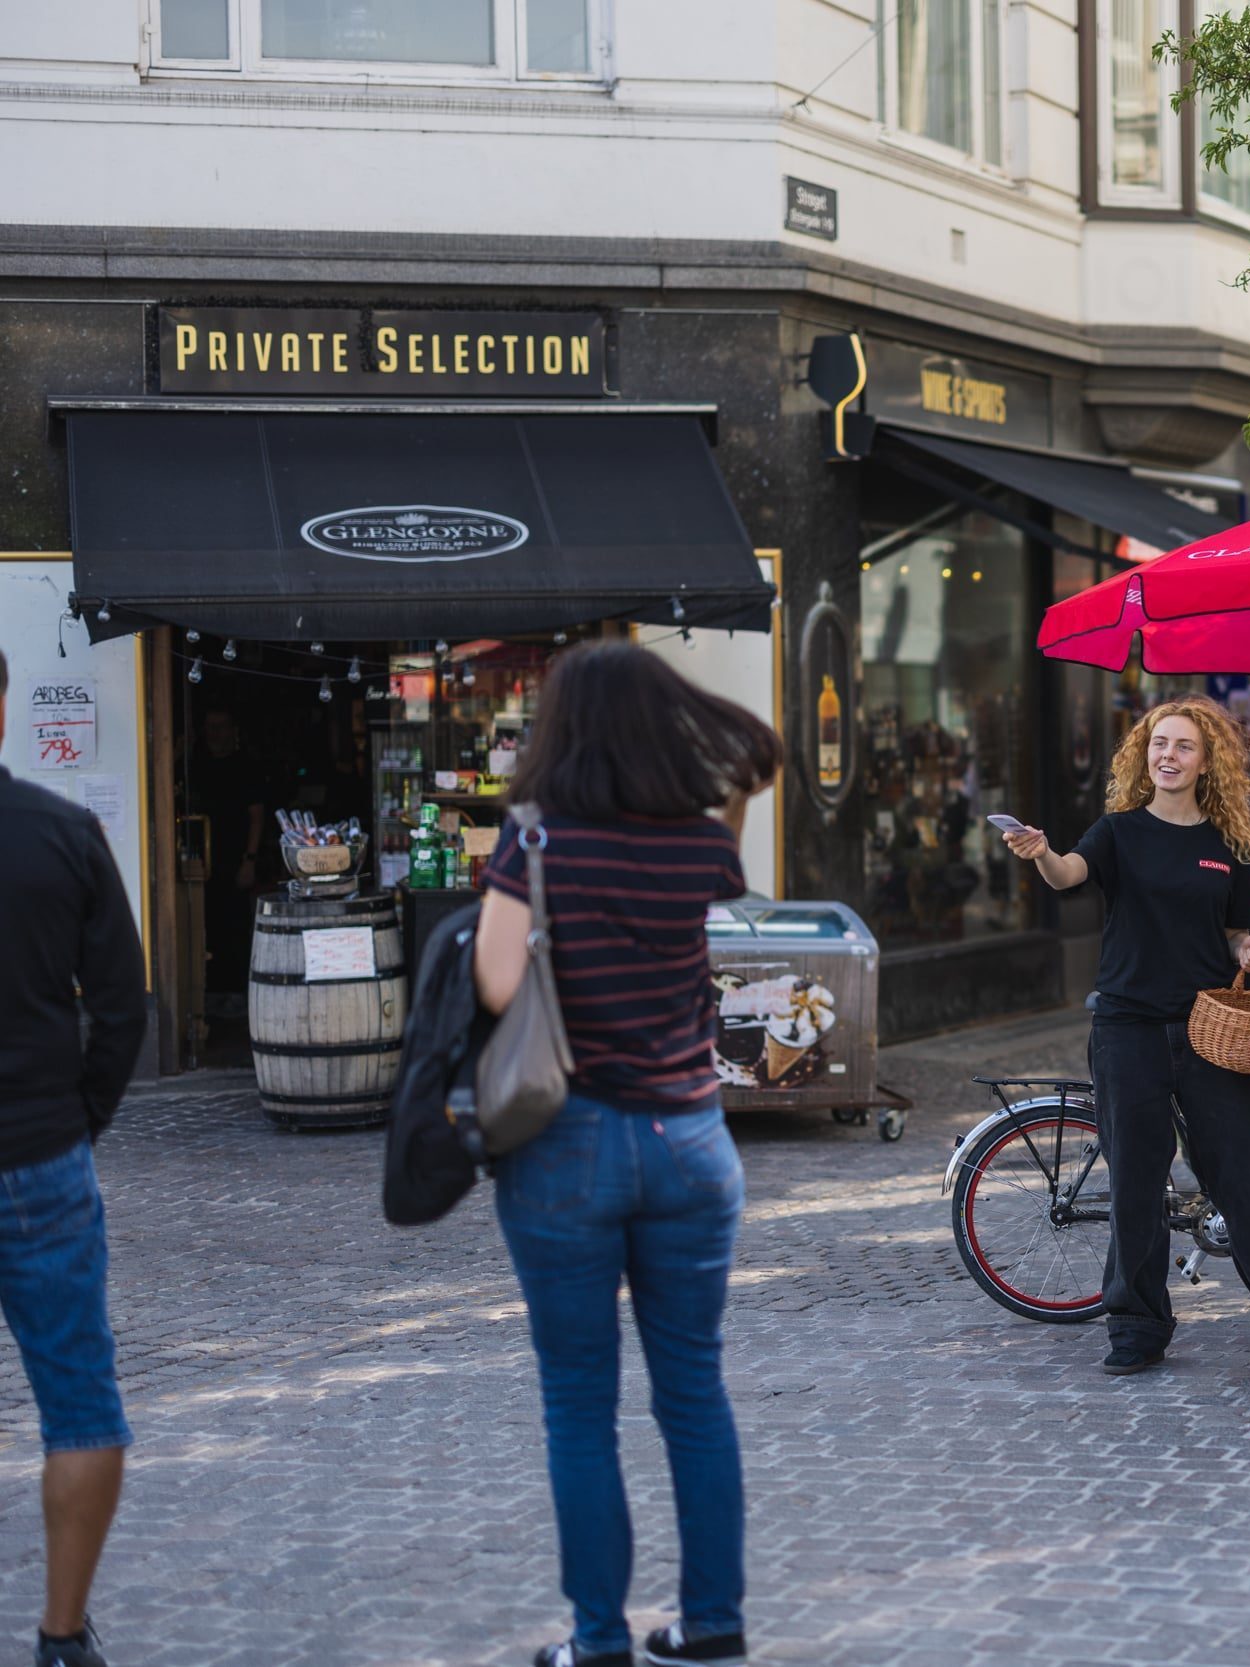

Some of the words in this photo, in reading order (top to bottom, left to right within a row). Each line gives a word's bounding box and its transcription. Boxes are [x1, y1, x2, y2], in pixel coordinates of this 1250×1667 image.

[176, 324, 348, 371] PRIVATE
[377, 326, 590, 375] SELECTION
[322, 525, 508, 540] GLENGOYNE
[32, 686, 89, 703] ARDBEG
